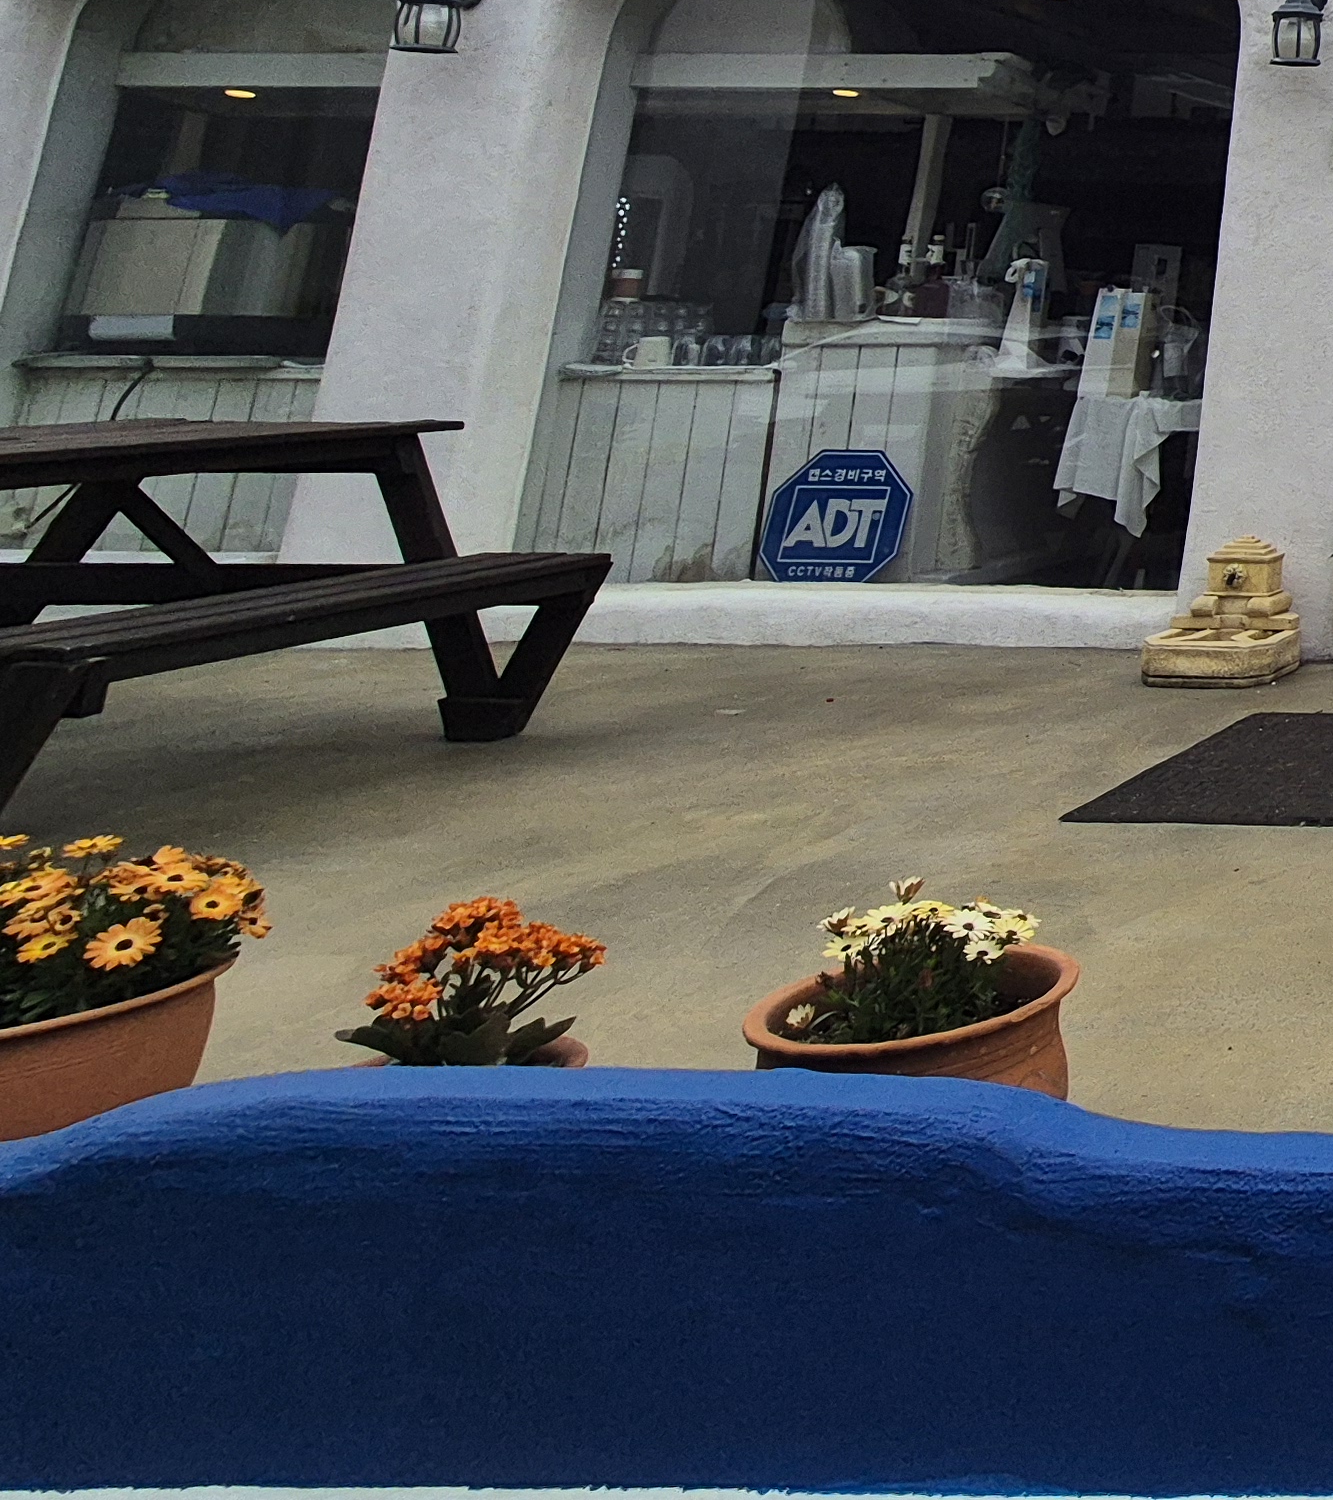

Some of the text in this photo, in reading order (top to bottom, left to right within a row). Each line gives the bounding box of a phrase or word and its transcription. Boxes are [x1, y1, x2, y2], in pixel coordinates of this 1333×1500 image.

[808, 468, 886, 482] 캡스경비구역
[783, 498, 888, 547] ADT
[788, 566, 855, 578] CCTV작동중
